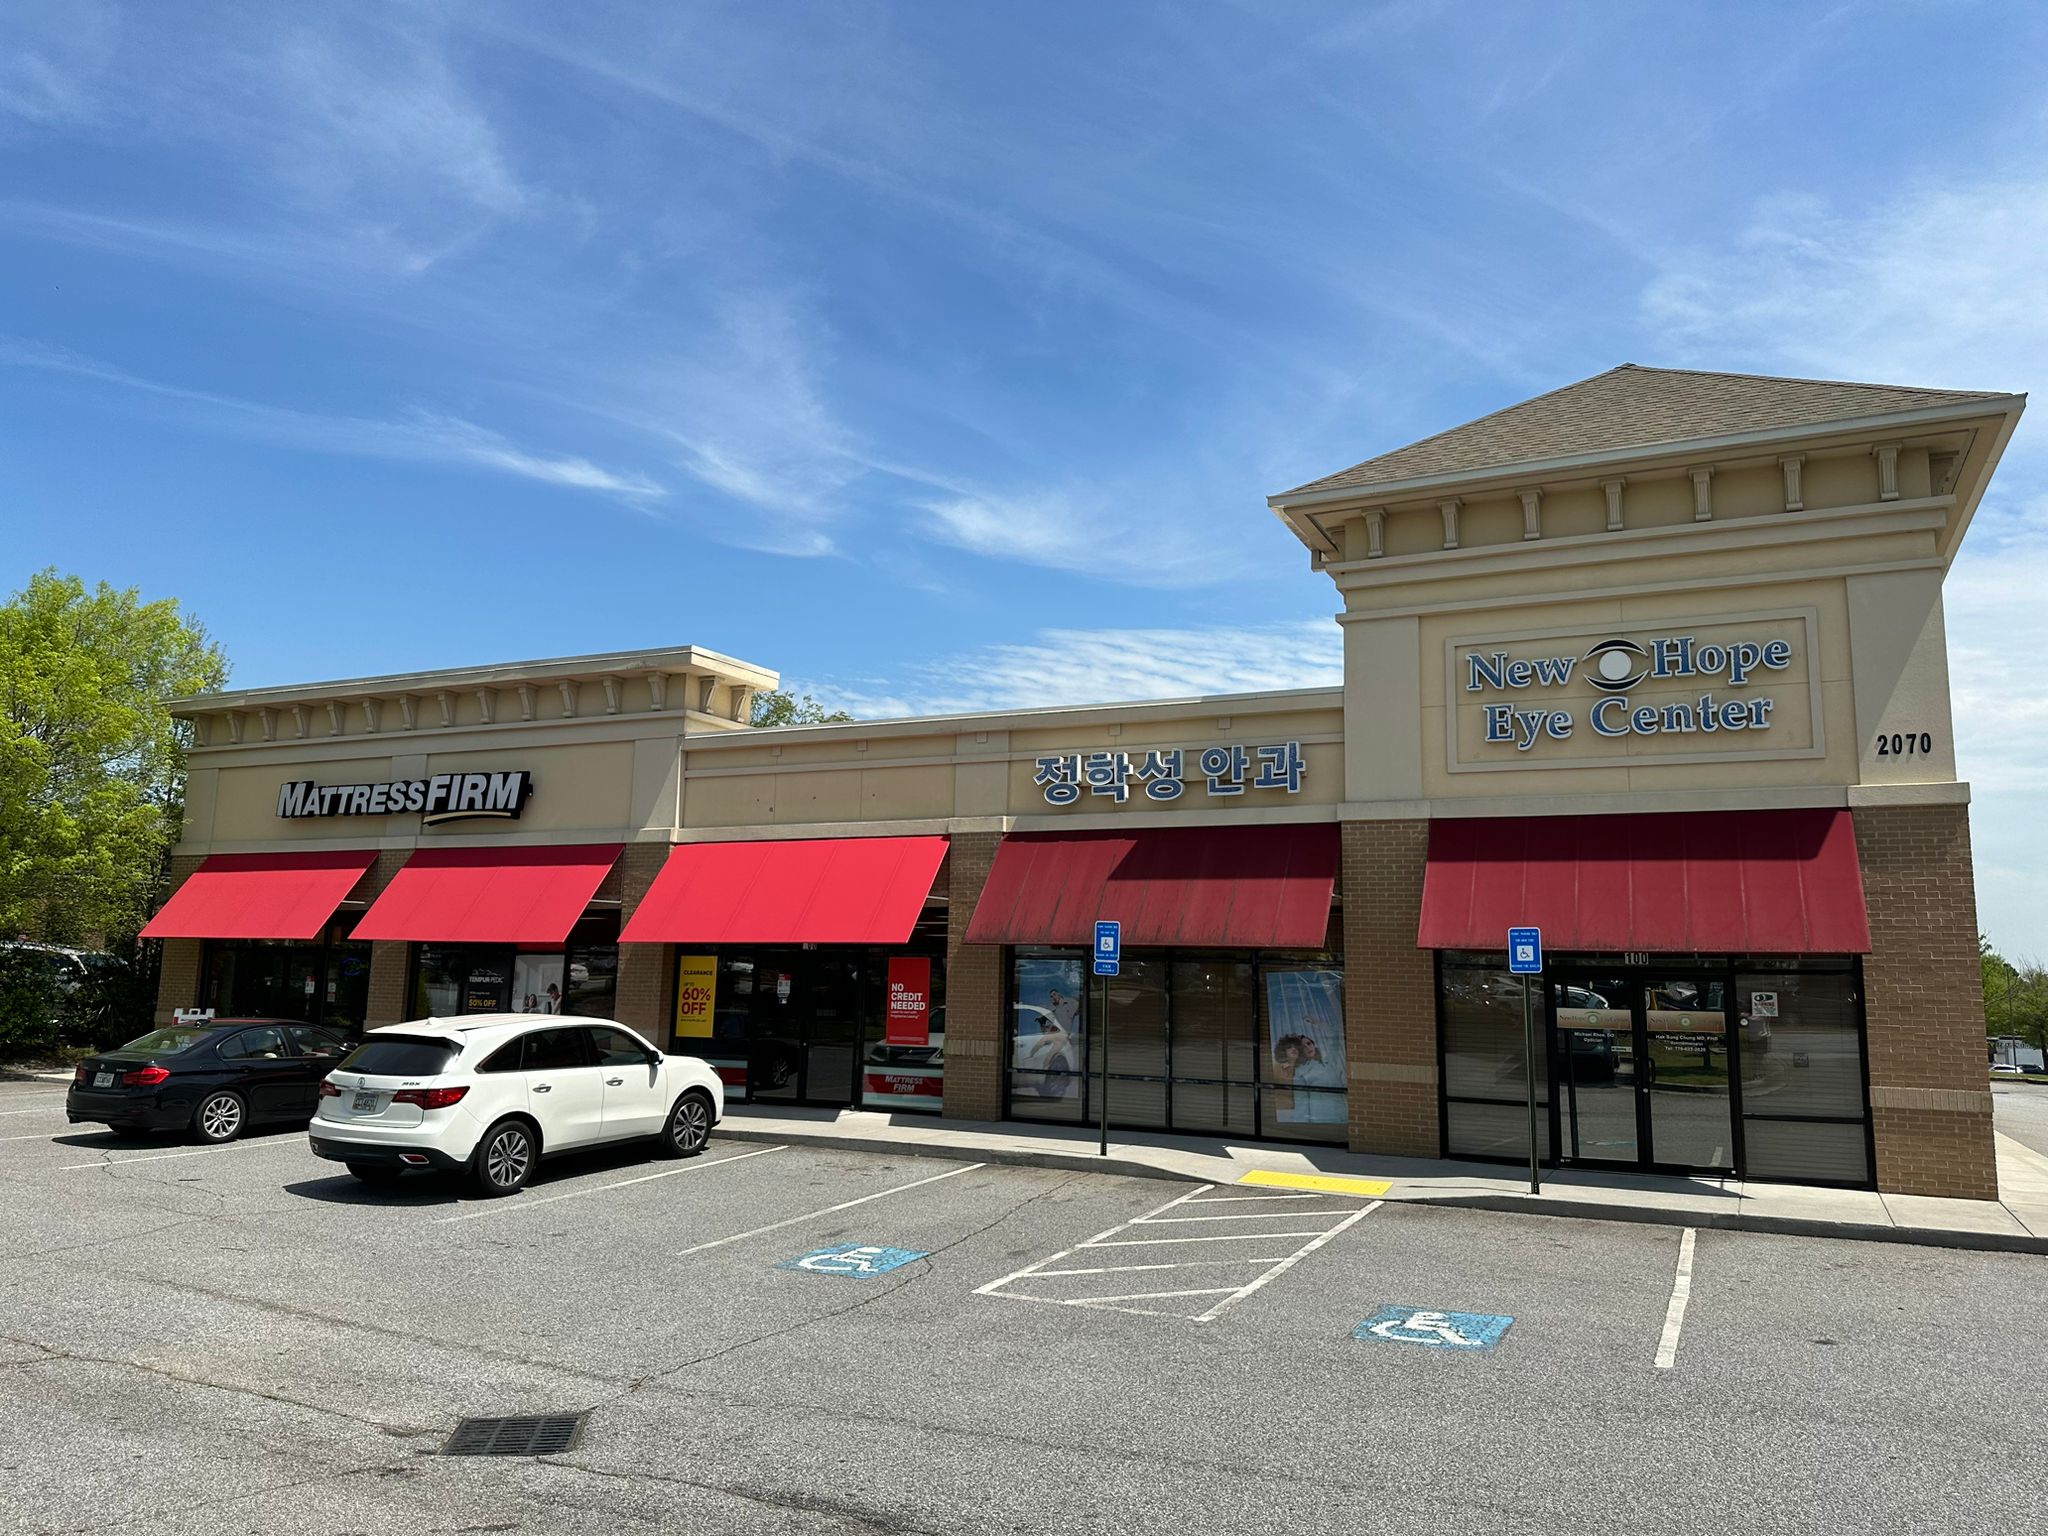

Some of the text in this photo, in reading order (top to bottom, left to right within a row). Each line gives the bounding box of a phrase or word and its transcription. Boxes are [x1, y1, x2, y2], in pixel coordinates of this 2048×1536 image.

[1466, 637, 1792, 692] New Hope
[1483, 693, 1773, 751] Eye Center
[1877, 732, 1932, 756] 2070
[1033, 741, 1306, 806] 정학성 안과
[1625, 952, 1649, 965] 100
[891, 983, 904, 992] NO
[682, 988, 711, 1001] 60%
[891, 993, 923, 1002] CREDIT
[469, 999, 497, 1007] 50% OFF
[681, 1002, 707, 1015] OFF
[890, 1002, 926, 1011] NEEDED
[885, 1075, 923, 1085] MATTRESS
[893, 1084, 915, 1093] FIRM
